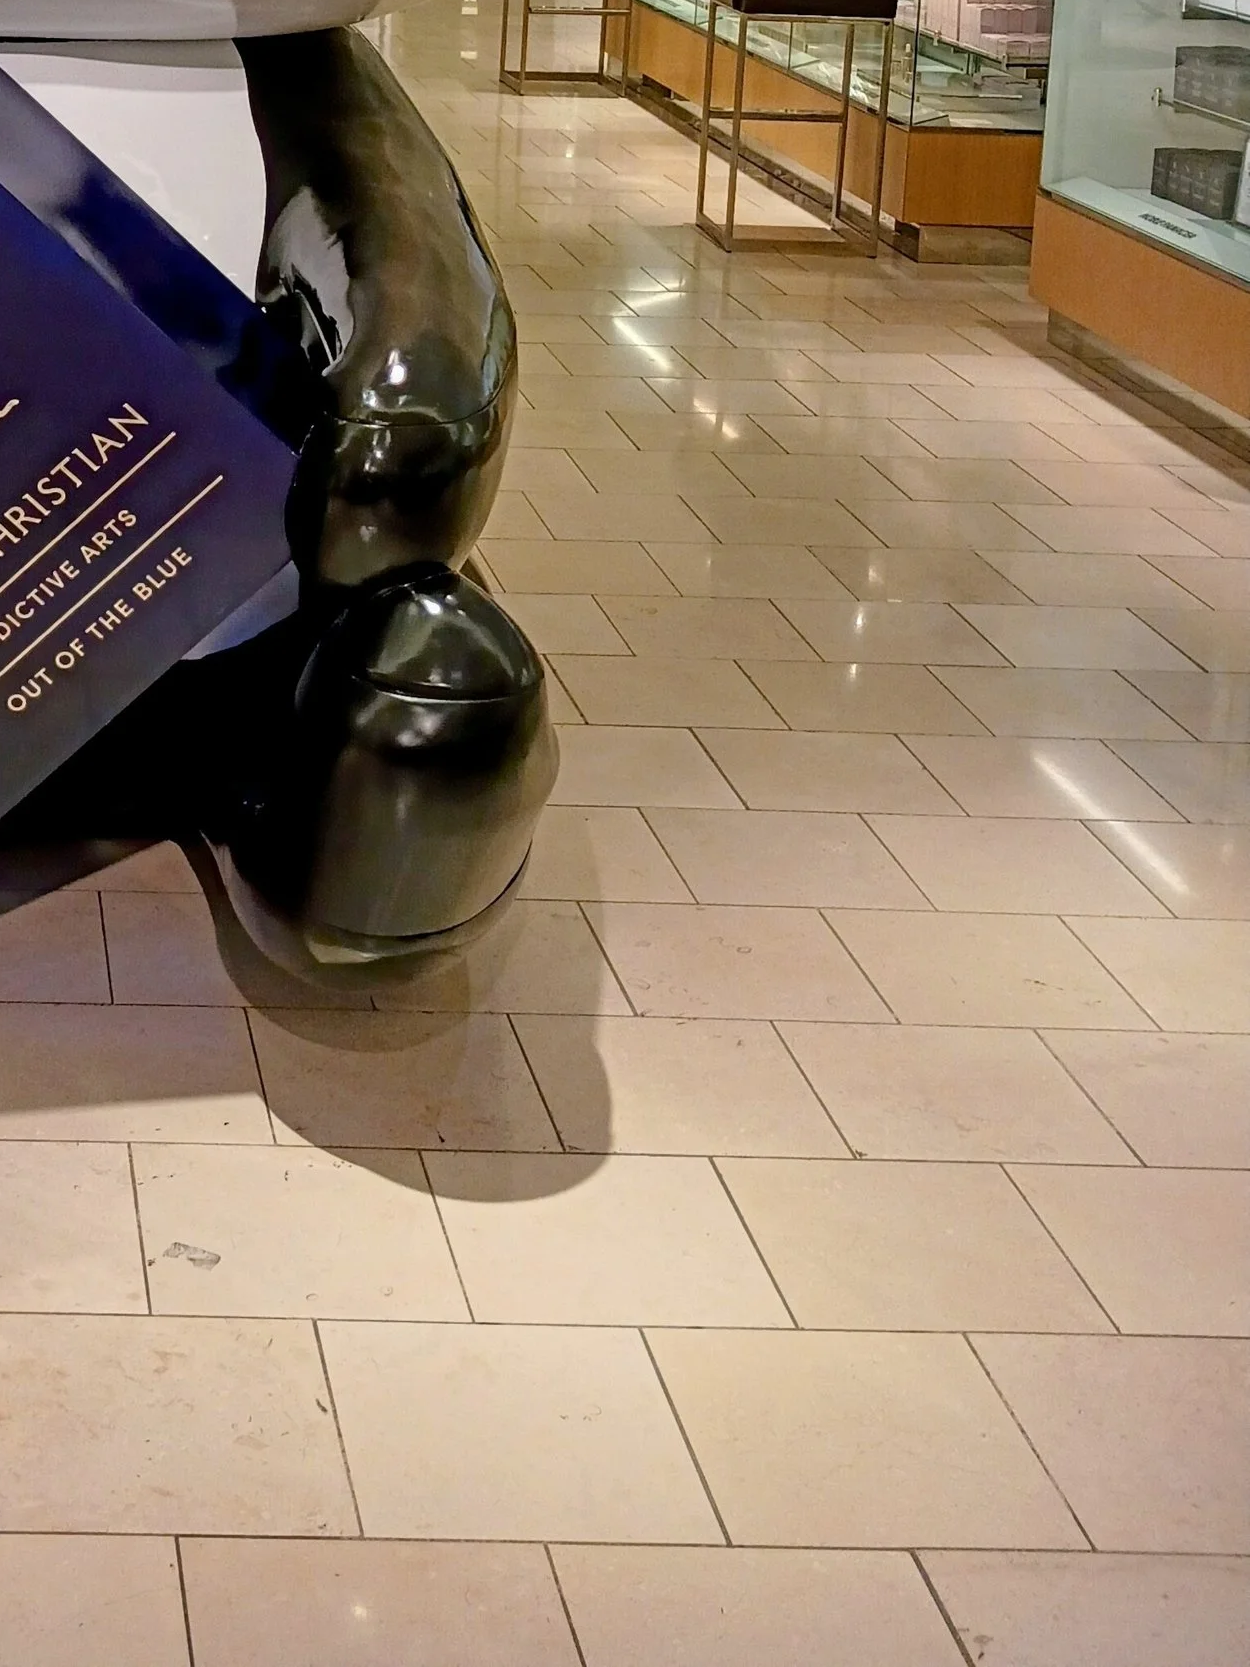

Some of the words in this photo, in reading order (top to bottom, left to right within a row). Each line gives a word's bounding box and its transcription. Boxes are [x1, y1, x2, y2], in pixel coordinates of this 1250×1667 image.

[79, 509, 138, 564] ARTS
[7, 667, 54, 712] OUT
[54, 637, 87, 670] OF
[84, 598, 135, 641] THE
[132, 546, 193, 601] BLUE
